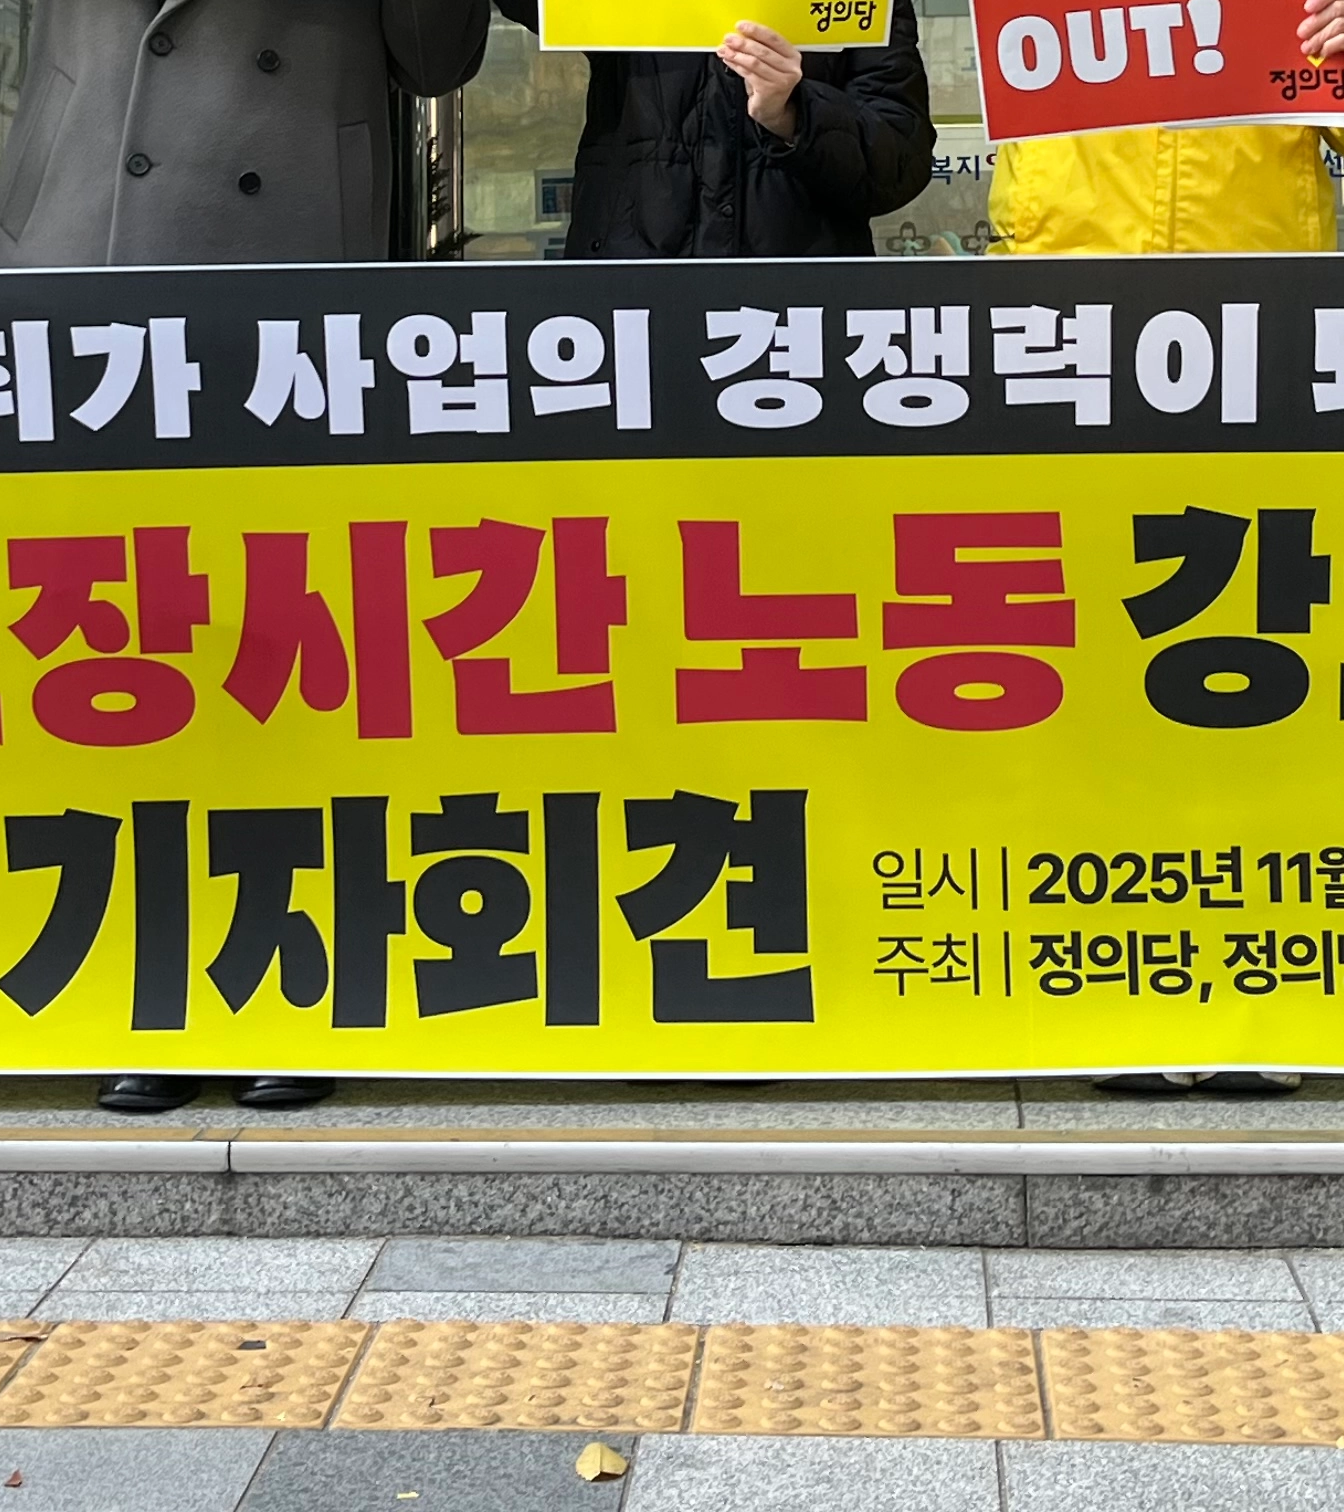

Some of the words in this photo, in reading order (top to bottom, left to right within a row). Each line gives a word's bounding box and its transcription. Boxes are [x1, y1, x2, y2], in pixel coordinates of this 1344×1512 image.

[809, 0, 878, 33] 정의당
[243, 306, 652, 437] 사업의
[700, 300, 1261, 431] 경쟁력이
[674, 509, 1077, 733] 노동
[871, 848, 980, 910] 일시
[1027, 846, 1245, 909] 2025년
[871, 932, 982, 997] 주최
[1027, 929, 1213, 1006] 정의당,
